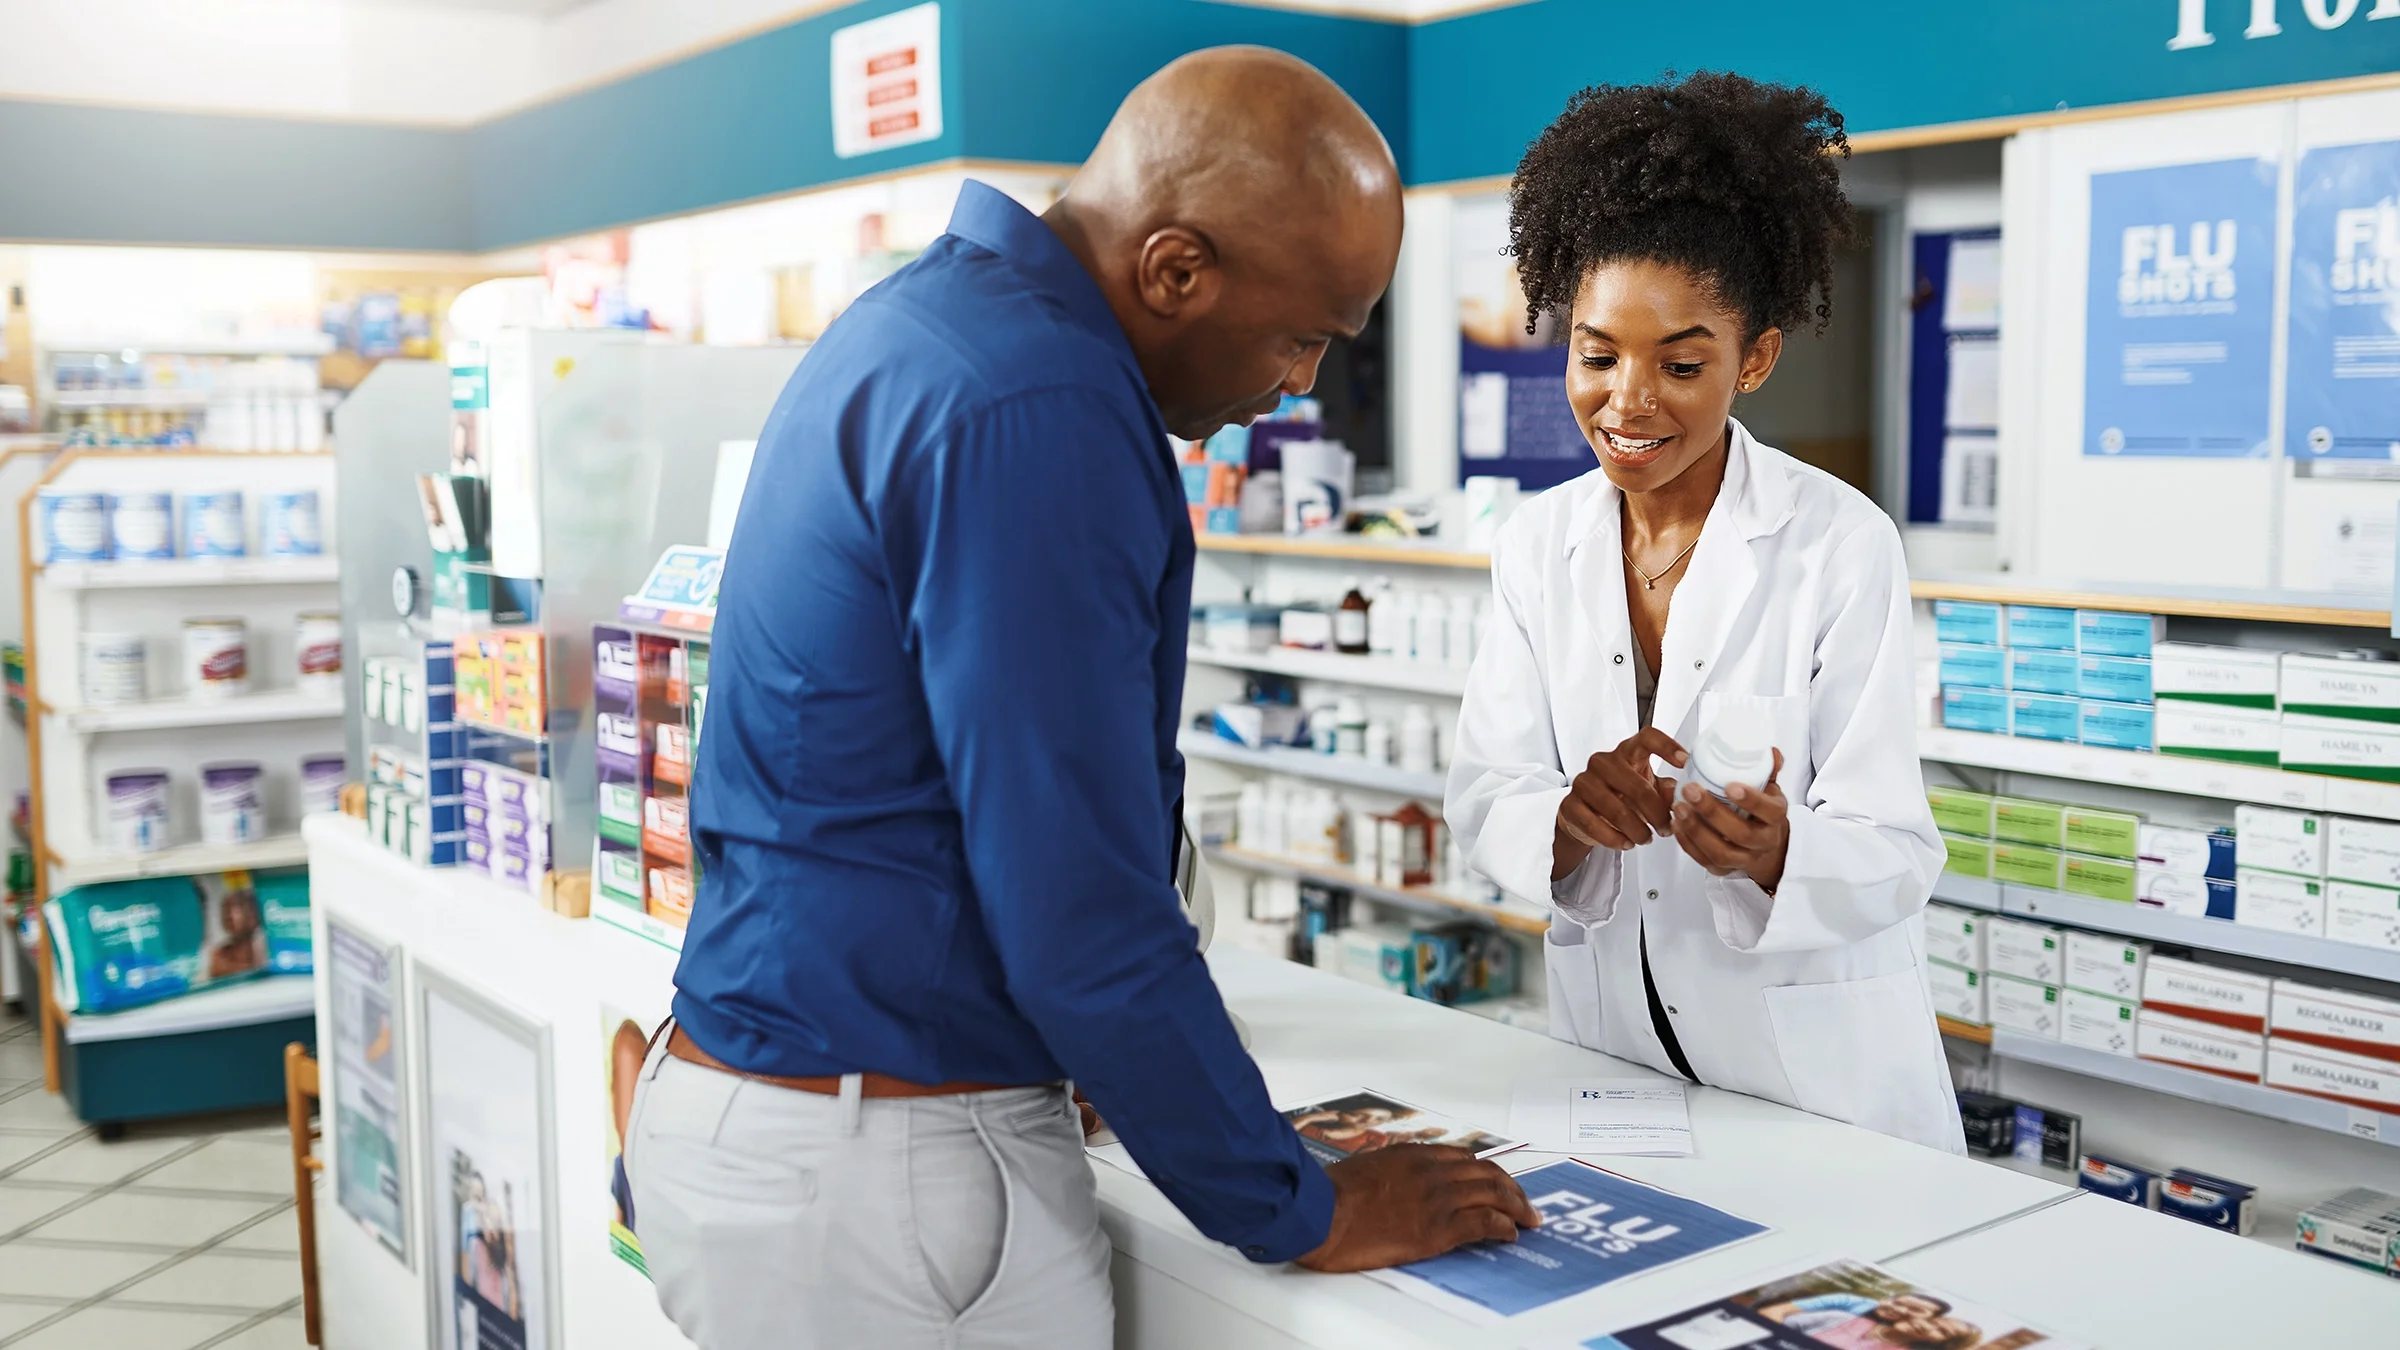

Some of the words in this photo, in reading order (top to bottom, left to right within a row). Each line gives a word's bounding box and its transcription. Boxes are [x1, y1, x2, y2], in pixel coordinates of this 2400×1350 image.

[2121, 219, 2238, 275] FLU
[2118, 267, 2237, 304] SHOTS
[2296, 1006, 2384, 1033] REGMAARKER
[2291, 1062, 2380, 1091] REGMAARKER
[1531, 1189, 1682, 1243] FLU
